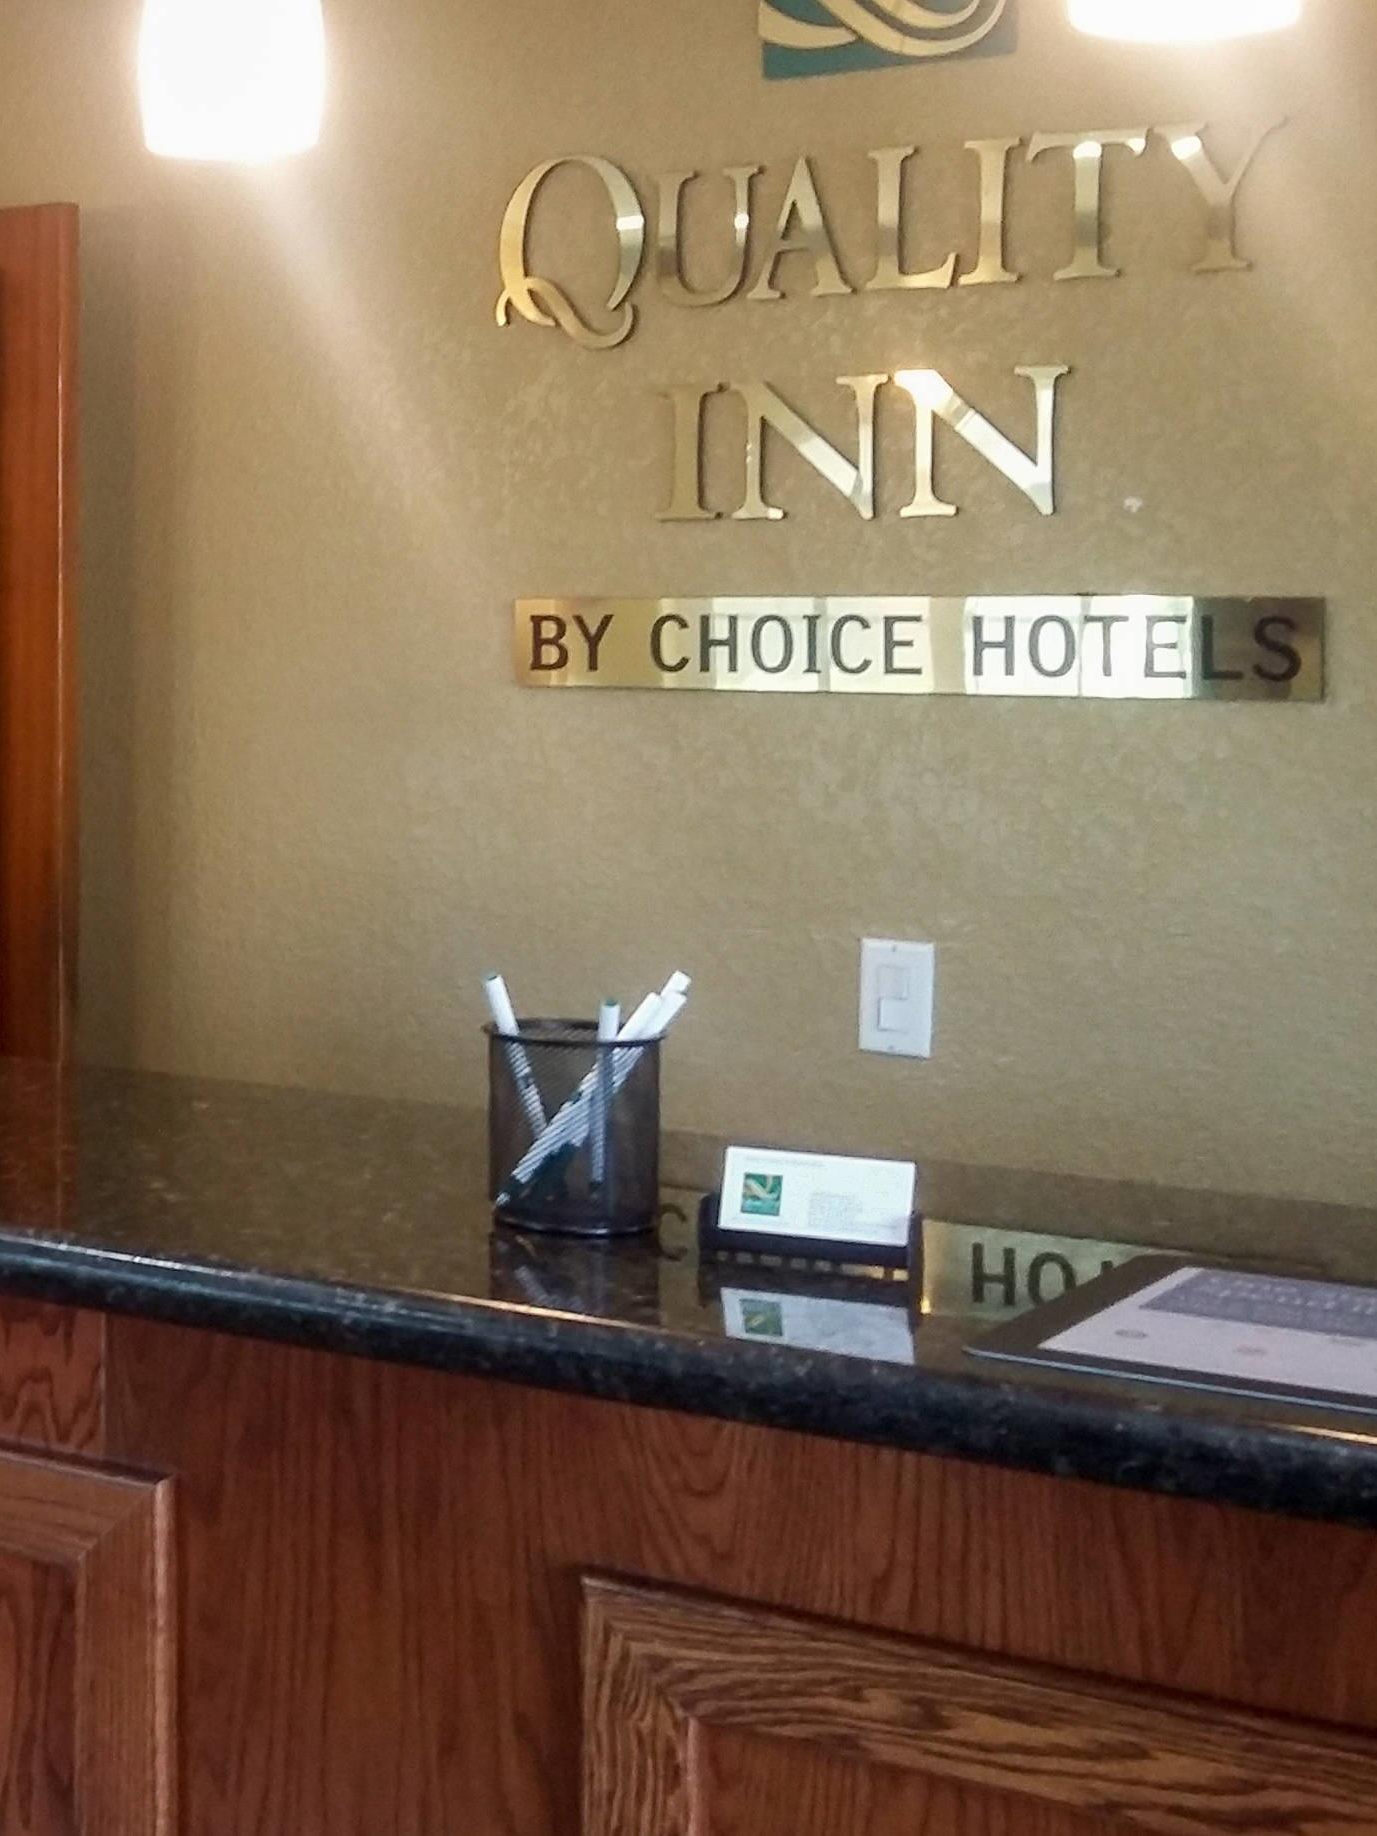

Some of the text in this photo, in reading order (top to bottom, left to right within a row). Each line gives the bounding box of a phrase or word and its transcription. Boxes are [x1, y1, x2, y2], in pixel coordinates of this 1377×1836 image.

[495, 117, 1288, 349] QUALITY
[654, 364, 1071, 520] INN
[529, 613, 1302, 682] BY CHOICE HOTELS
